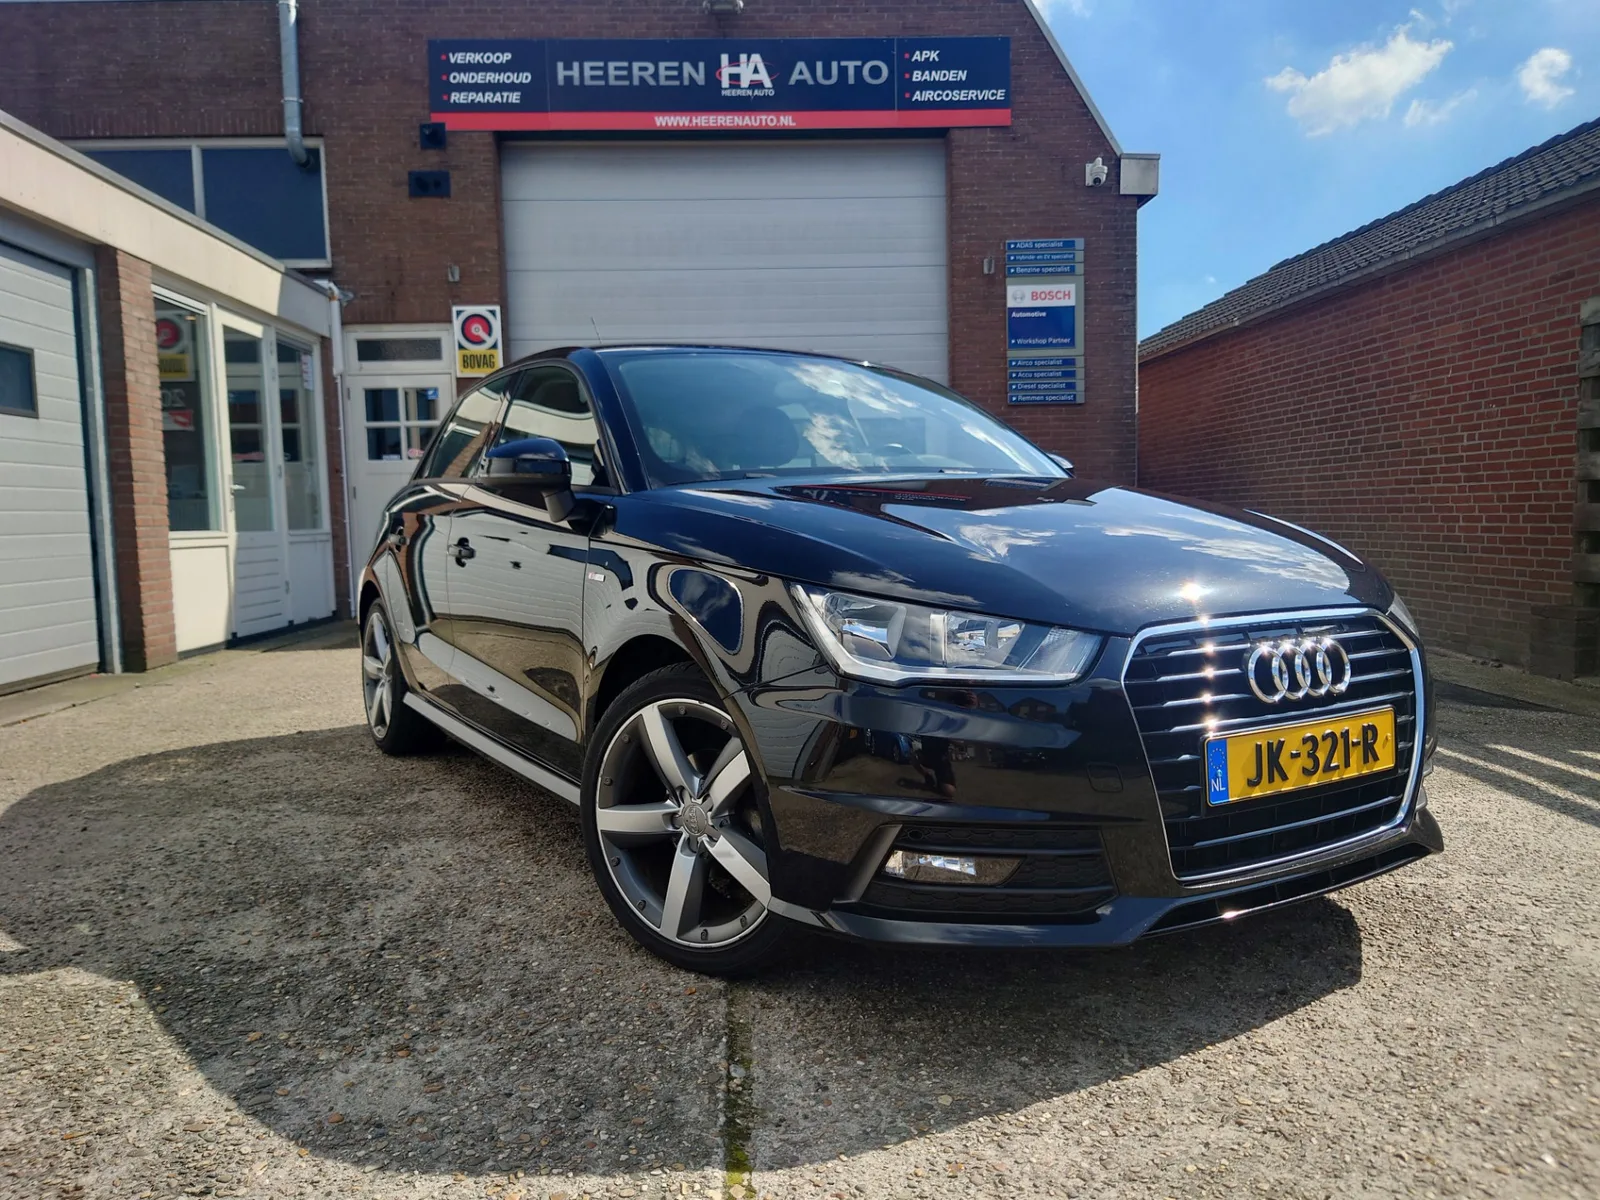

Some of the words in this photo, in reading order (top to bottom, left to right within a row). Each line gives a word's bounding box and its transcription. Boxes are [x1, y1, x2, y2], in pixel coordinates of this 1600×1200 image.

[449, 52, 512, 64] VERKOOP
[911, 50, 940, 62] APK
[556, 61, 705, 86] HEEREN
[720, 53, 773, 89] HA
[788, 61, 889, 85] AUTO
[911, 70, 967, 82] BANDEN
[449, 72, 531, 84] ONDERHOUD
[450, 92, 521, 104] REPARATIE
[721, 89, 752, 97] HEEREN
[753, 89, 775, 97] AUTO
[911, 89, 1006, 102] AIRCOSERVICE
[654, 115, 796, 127] WWW.HEERENAUTO.NL
[1034, 241, 1063, 249] specialist
[1041, 266, 1070, 274] specialist
[1031, 290, 1071, 301] BOSCH
[462, 353, 496, 369] BOVAG
[1034, 359, 1063, 367] specialist
[1037, 382, 1066, 390] specialist
[1045, 394, 1074, 402] specialist
[1246, 722, 1379, 788] JK-321-R
[1211, 778, 1226, 792] NL
